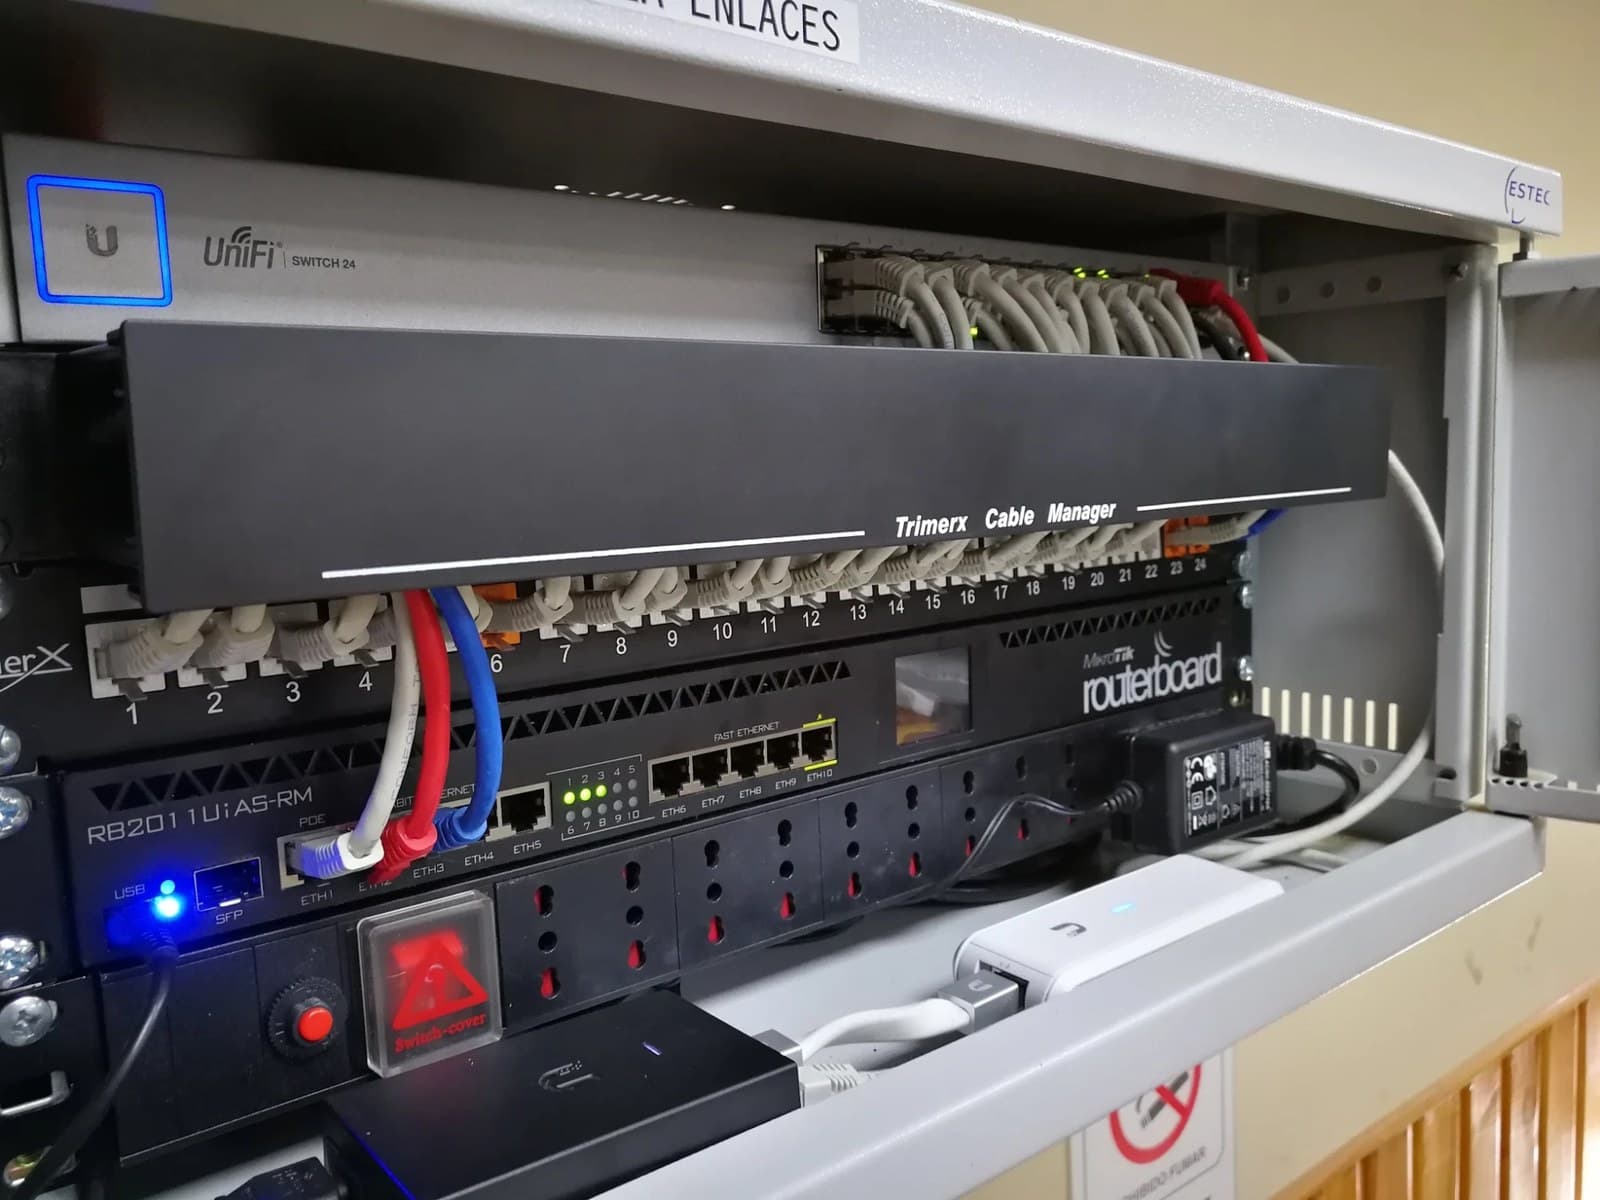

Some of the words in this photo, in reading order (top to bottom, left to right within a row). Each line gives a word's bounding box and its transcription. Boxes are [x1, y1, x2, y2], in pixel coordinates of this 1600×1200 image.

[1508, 180, 1552, 207] ESTEC
[291, 255, 340, 270] SWITCH
[342, 258, 356, 270] 24
[895, 513, 968, 539] Trimerx
[985, 507, 1036, 531] Cable
[1048, 501, 1118, 525] Manager
[124, 702, 140, 725] 1
[206, 691, 224, 714] 2
[285, 680, 302, 703] 3
[357, 670, 374, 692] 4
[490, 653, 504, 673] 6
[558, 644, 571, 664] 7
[614, 636, 628, 656] 8
[666, 629, 679, 648] 9
[711, 621, 734, 641] 10
[760, 614, 778, 634] 11
[801, 609, 822, 628] 12
[850, 603, 868, 622] 13
[888, 597, 906, 616] 14
[926, 594, 942, 611] 15
[960, 588, 977, 605] 16
[994, 583, 1009, 601] 17
[1026, 579, 1042, 597] 18
[1062, 575, 1077, 592] 19
[1090, 571, 1106, 588] 20
[1119, 567, 1133, 584] 21
[1144, 562, 1160, 580] 22
[1170, 560, 1185, 577] 23
[1194, 557, 1208, 573] 24
[0, 643, 72, 678] erX
[1083, 641, 1222, 714] routerboard
[713, 730, 735, 743] FAST
[736, 720, 781, 738] ETHERNET
[581, 774, 589, 783] 2
[597, 771, 605, 780] 3
[613, 766, 621, 777] 4
[628, 765, 636, 774] 5
[299, 813, 326, 828] POE
[567, 825, 575, 835] 6
[583, 821, 591, 831] 7
[598, 817, 607, 828] 8
[615, 814, 622, 823] 9
[627, 810, 640, 820] 10
[301, 889, 334, 906] ETH1
[413, 863, 445, 879] ETH3
[464, 851, 494, 866] ETH4
[513, 840, 542, 855] ETH5
[661, 805, 687, 818] ETH6
[701, 795, 726, 808] ETH7
[739, 785, 762, 799] ETH8
[775, 778, 797, 790] ETH9
[807, 769, 833, 782] ETH10
[113, 884, 146, 900] USB
[215, 909, 244, 924] SFP
[394, 1014, 486, 1054] Switch-cover
